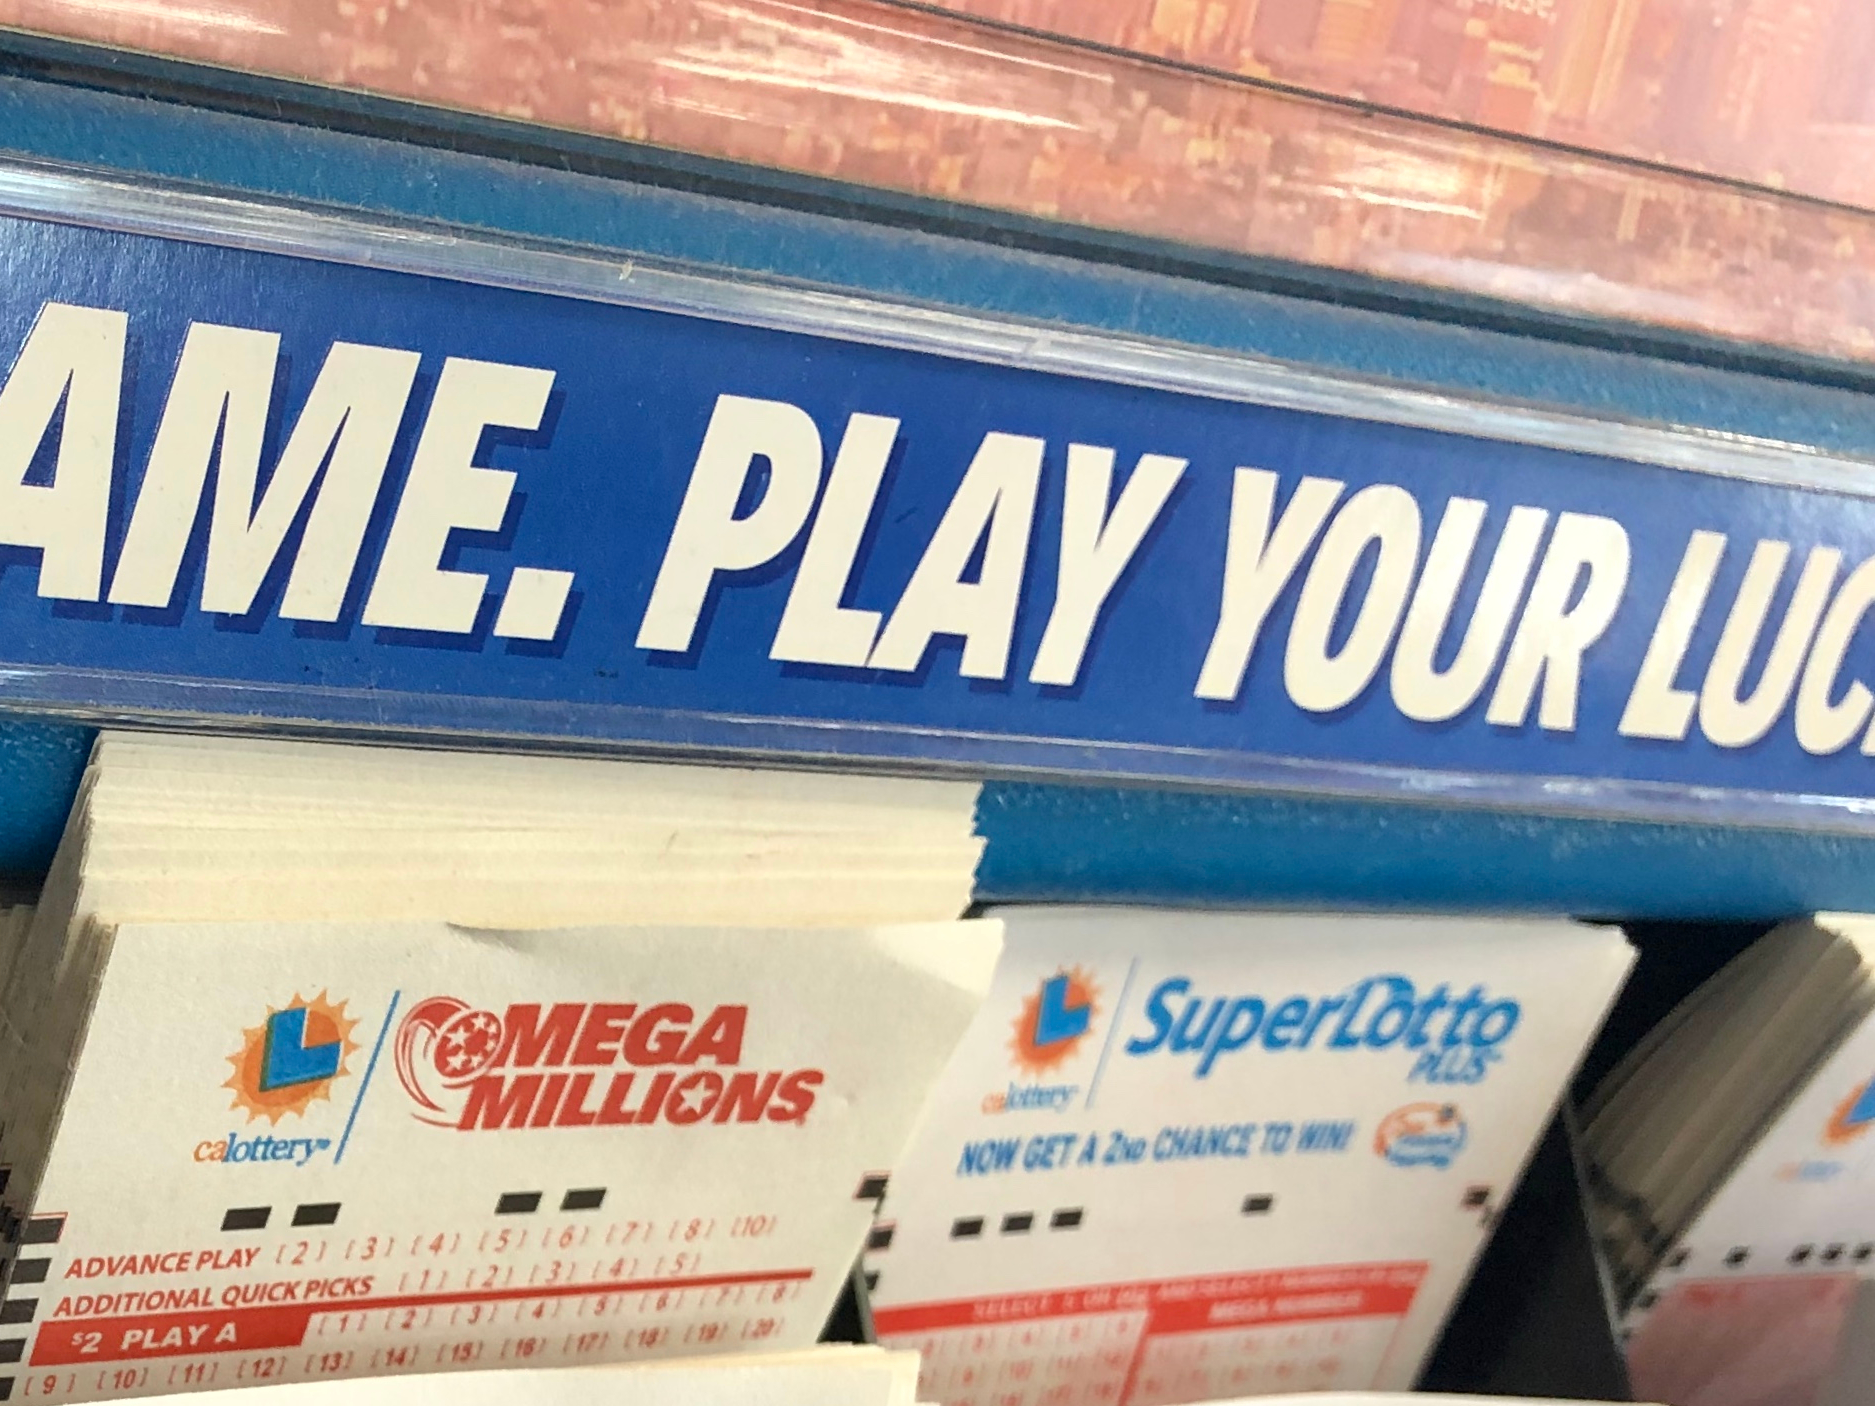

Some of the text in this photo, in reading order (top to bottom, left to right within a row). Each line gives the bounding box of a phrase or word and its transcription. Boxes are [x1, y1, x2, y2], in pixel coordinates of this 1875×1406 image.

[635, 394, 1188, 690] PLAY
[1193, 466, 1631, 733] YOUR
[1615, 528, 1875, 757] LUC
[492, 1002, 748, 1067] MEGA
[1126, 973, 1521, 1080] SuperLotto
[456, 1069, 825, 1131] MILLIONS
[193, 1132, 325, 1167] calottery
[956, 1136, 1021, 1178] NOW
[1023, 1132, 1077, 1173] GET
[1077, 1130, 1098, 1166] A
[1152, 1122, 1256, 1163] CHANCE
[1260, 1121, 1294, 1156] TO
[64, 1247, 261, 1280] ADVANCE PLAY
[53, 1275, 374, 1317] ADDITIONAL QUICK PICKS
[71, 1322, 238, 1354] $2 PLAY A
